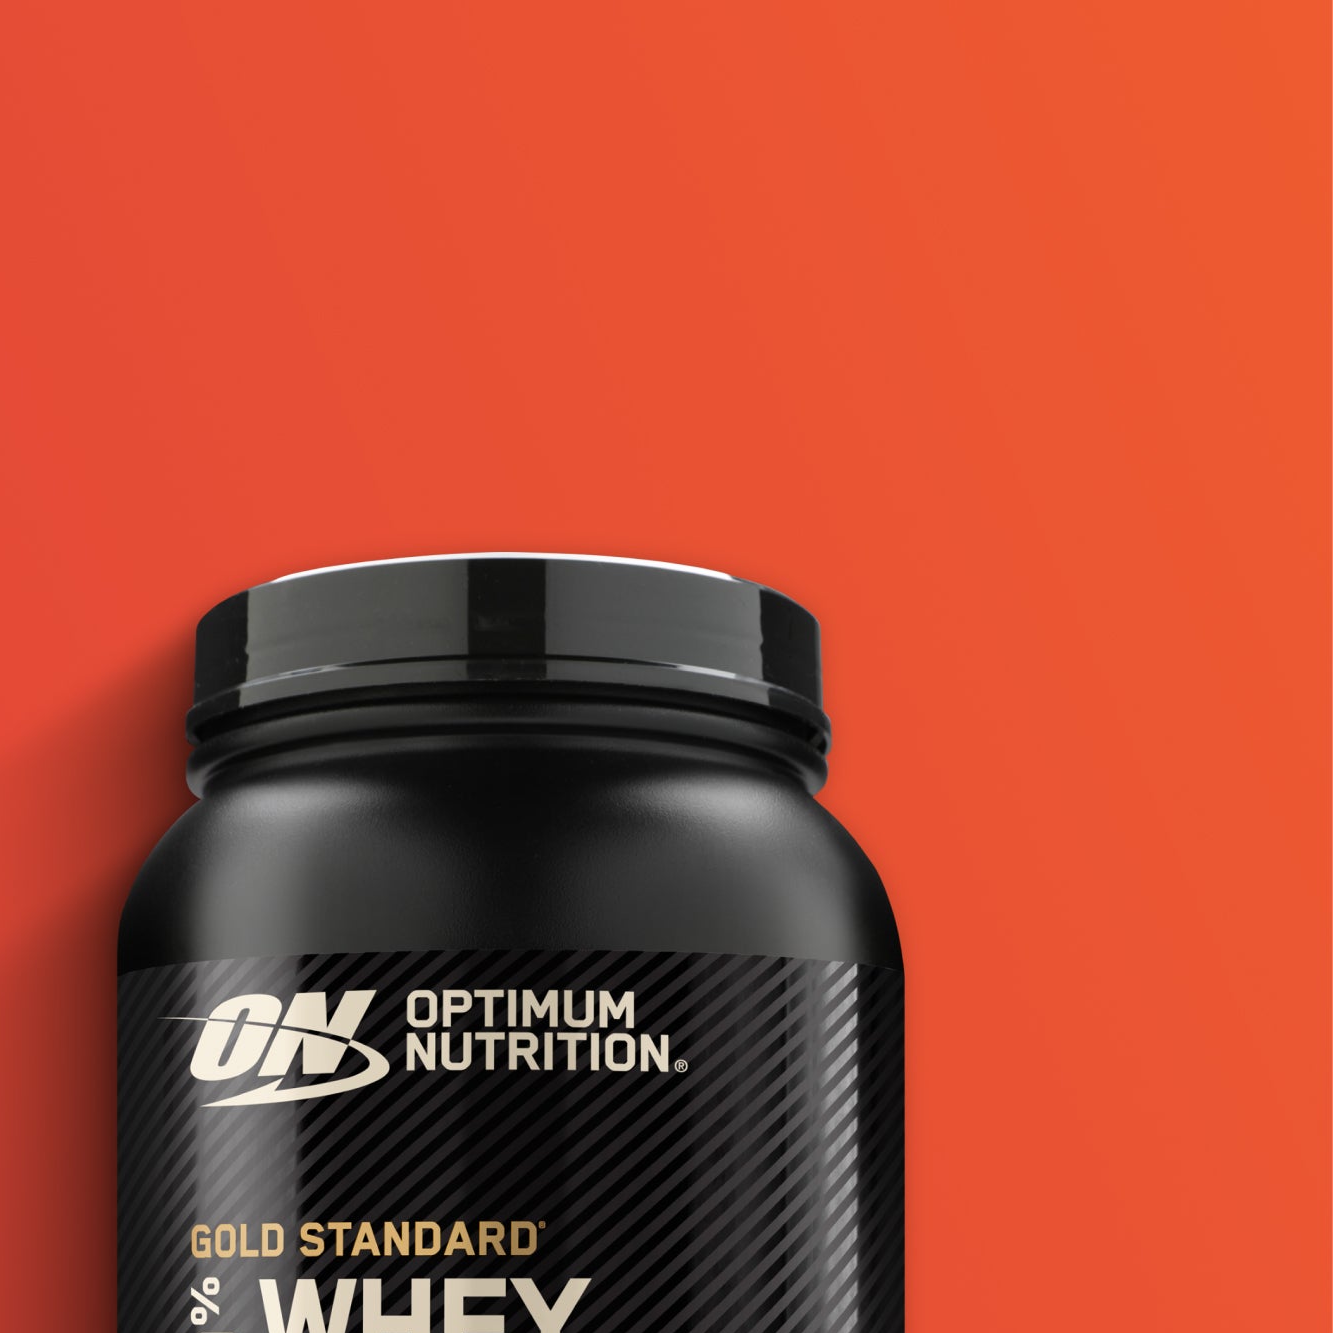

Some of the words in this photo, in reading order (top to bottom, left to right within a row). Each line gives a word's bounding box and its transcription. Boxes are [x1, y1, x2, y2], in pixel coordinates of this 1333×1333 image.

[189, 988, 390, 1095] ON
[405, 989, 636, 1030] OPTIMUM
[190, 1223, 285, 1260] GOLD
